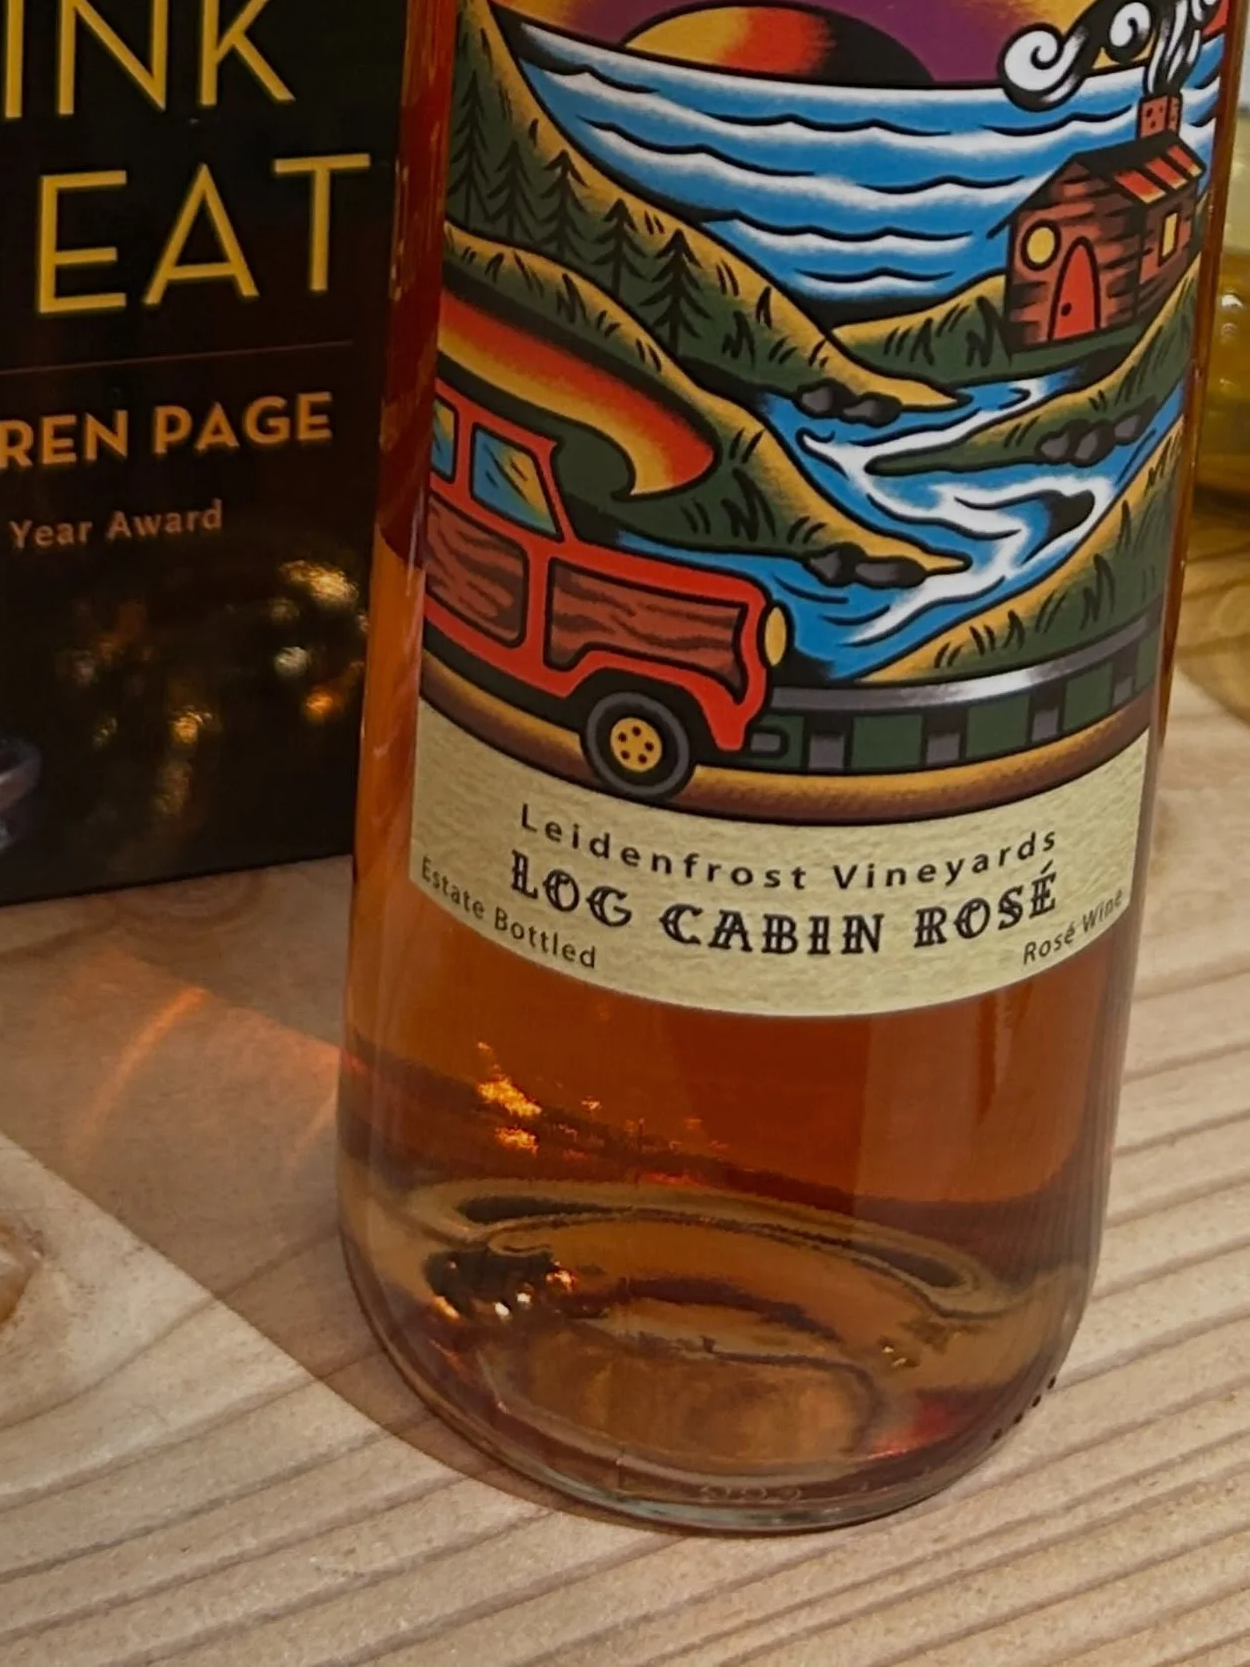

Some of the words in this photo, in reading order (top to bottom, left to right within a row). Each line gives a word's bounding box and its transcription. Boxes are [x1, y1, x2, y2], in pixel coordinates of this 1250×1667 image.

[38, 153, 372, 316] EAT
[154, 392, 333, 455] PAGE
[8, 516, 92, 549] Year
[106, 498, 224, 539] Award
[520, 803, 807, 889] Leidenfrost
[833, 830, 1057, 890] Vineyards
[421, 855, 486, 922] Estate
[493, 908, 598, 969] Bottled
[511, 851, 633, 928] LOG
[658, 903, 885, 956] CABIN
[913, 858, 1059, 950] ROSÉ
[1022, 921, 1075, 966] Rosé
[1081, 889, 1124, 933] Wine
